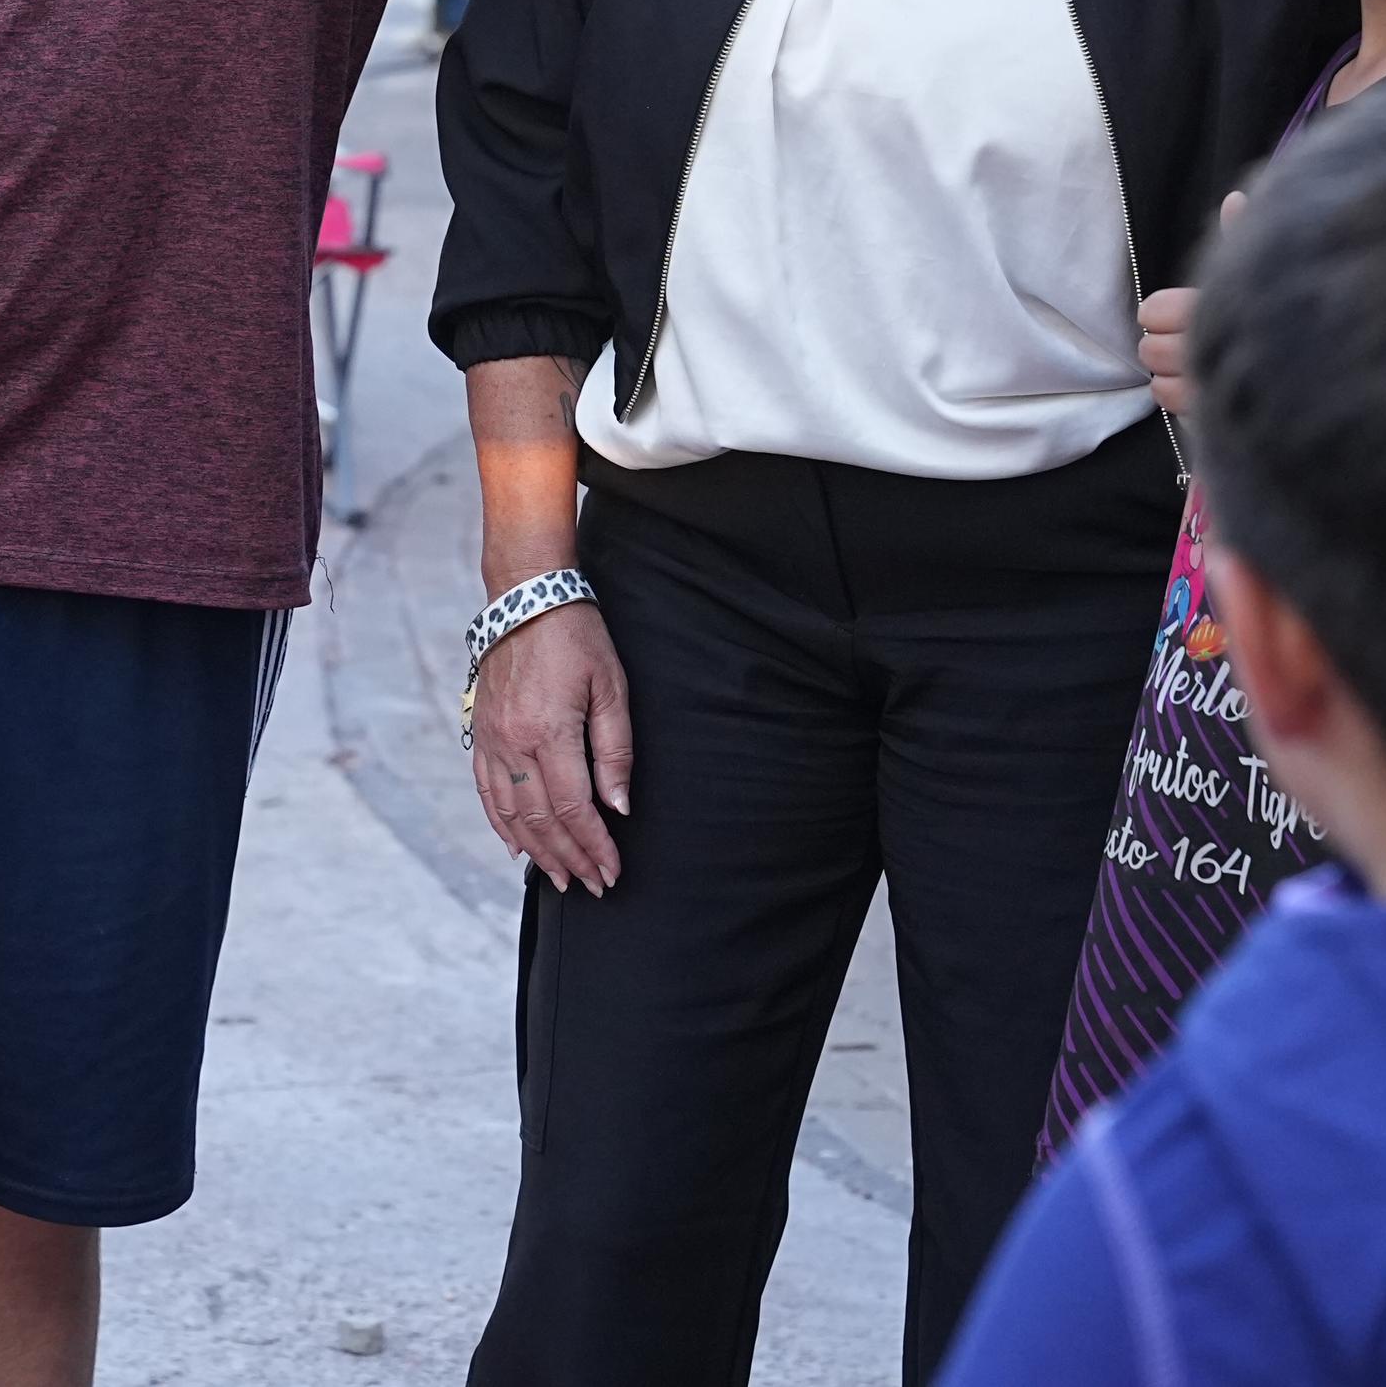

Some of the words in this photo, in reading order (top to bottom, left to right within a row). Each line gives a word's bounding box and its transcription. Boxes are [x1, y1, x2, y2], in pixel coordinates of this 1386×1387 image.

[1145, 638, 1253, 722] Merlo
[1128, 727, 1230, 807] frutos
[1104, 816, 1159, 870] sto
[1173, 836, 1252, 895] 164
